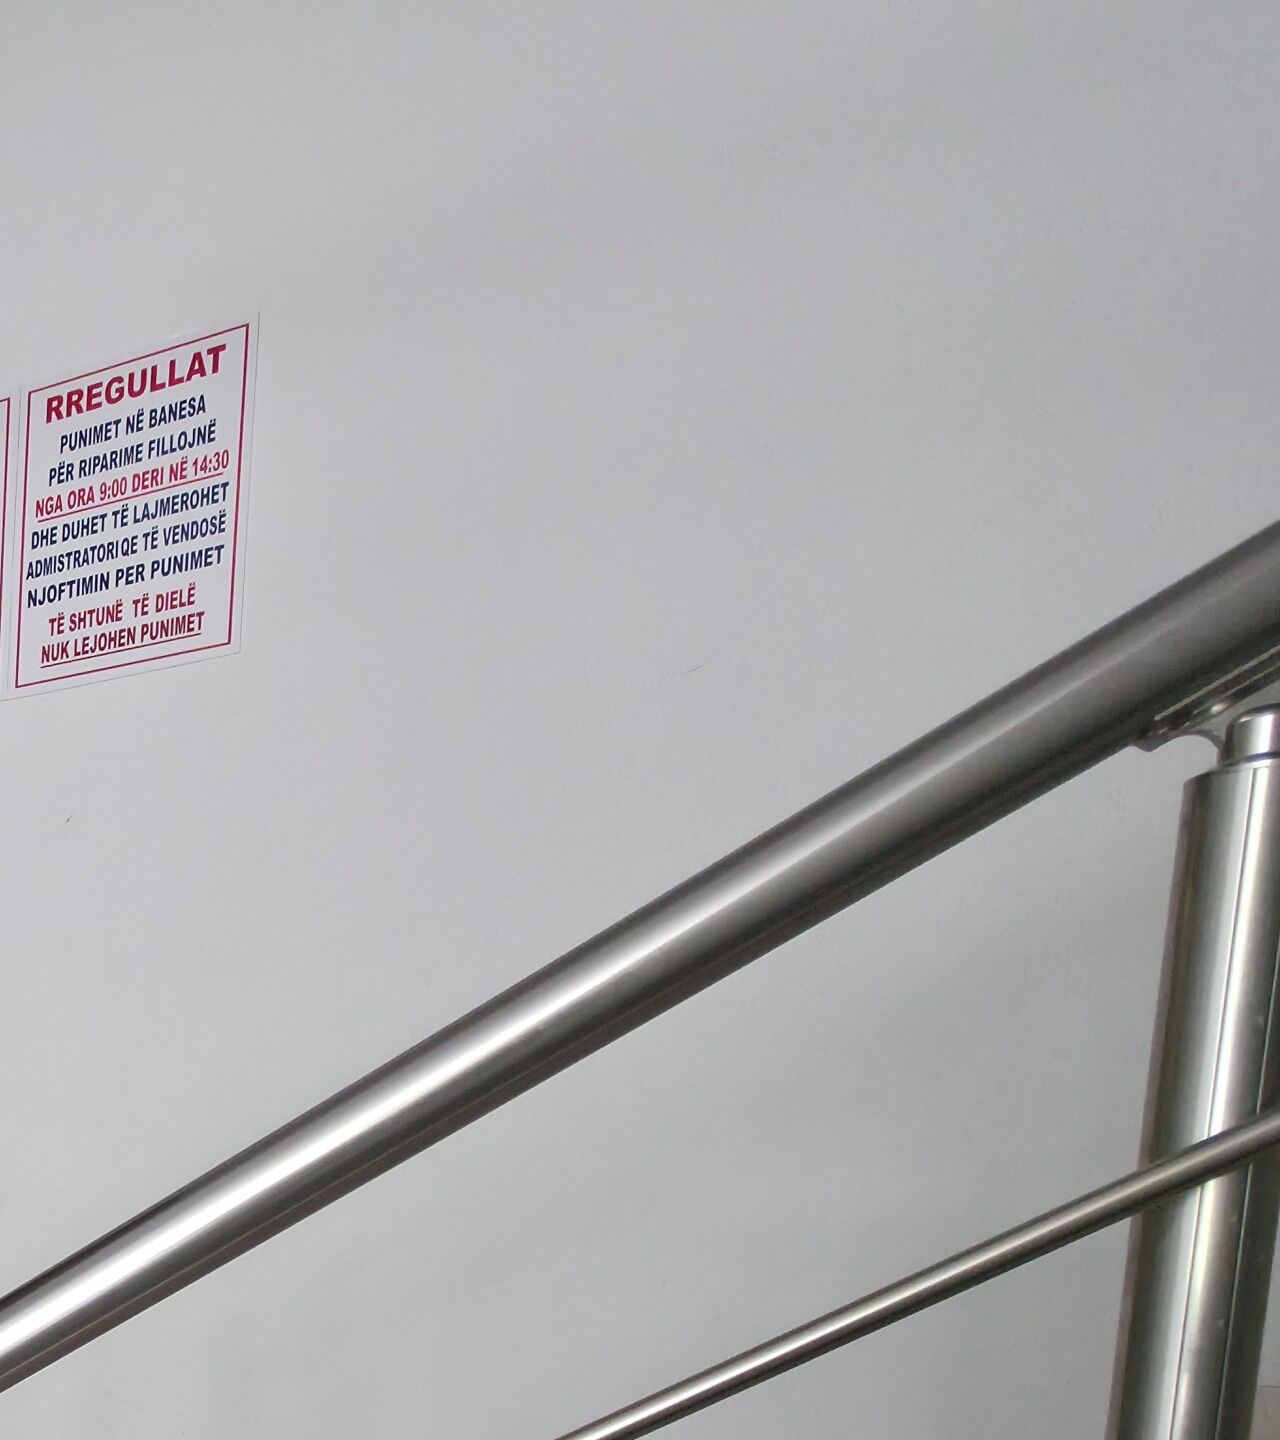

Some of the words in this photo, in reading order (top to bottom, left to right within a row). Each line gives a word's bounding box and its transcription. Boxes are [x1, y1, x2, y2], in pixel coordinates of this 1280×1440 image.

[46, 343, 227, 424] RREGULLAT
[48, 458, 75, 487] PËR
[78, 443, 144, 479] RIPARIME
[148, 418, 217, 460] FILLOJNË
[60, 418, 122, 454] PUNIMET
[125, 407, 145, 436] NË
[148, 394, 207, 428] BANESA
[31, 525, 58, 550] DHE
[61, 513, 108, 543] DUHET
[111, 503, 129, 529] TË
[132, 481, 230, 525] LAJMEROHET
[35, 494, 63, 518] NGA
[67, 485, 95, 510] ORA
[99, 476, 128, 501] 9:00
[131, 468, 164, 493] DERI
[169, 456, 188, 484] NË
[192, 449, 230, 477] 14:30
[26, 540, 119, 580] ADMISTRATORI
[120, 535, 138, 557] QE
[142, 526, 159, 551] TË
[162, 509, 227, 547] VENDOSË
[27, 571, 110, 608] NJOFTIMIN
[115, 564, 146, 588] PER
[150, 544, 225, 579] PUNIMET
[41, 641, 70, 664] NUK
[73, 626, 136, 657] LEJOHEN
[140, 611, 205, 643] PUNIMET
[48, 612, 65, 637] TË
[69, 599, 123, 633] SHTUNË
[132, 593, 149, 618] TË
[155, 582, 196, 613] DIELË
